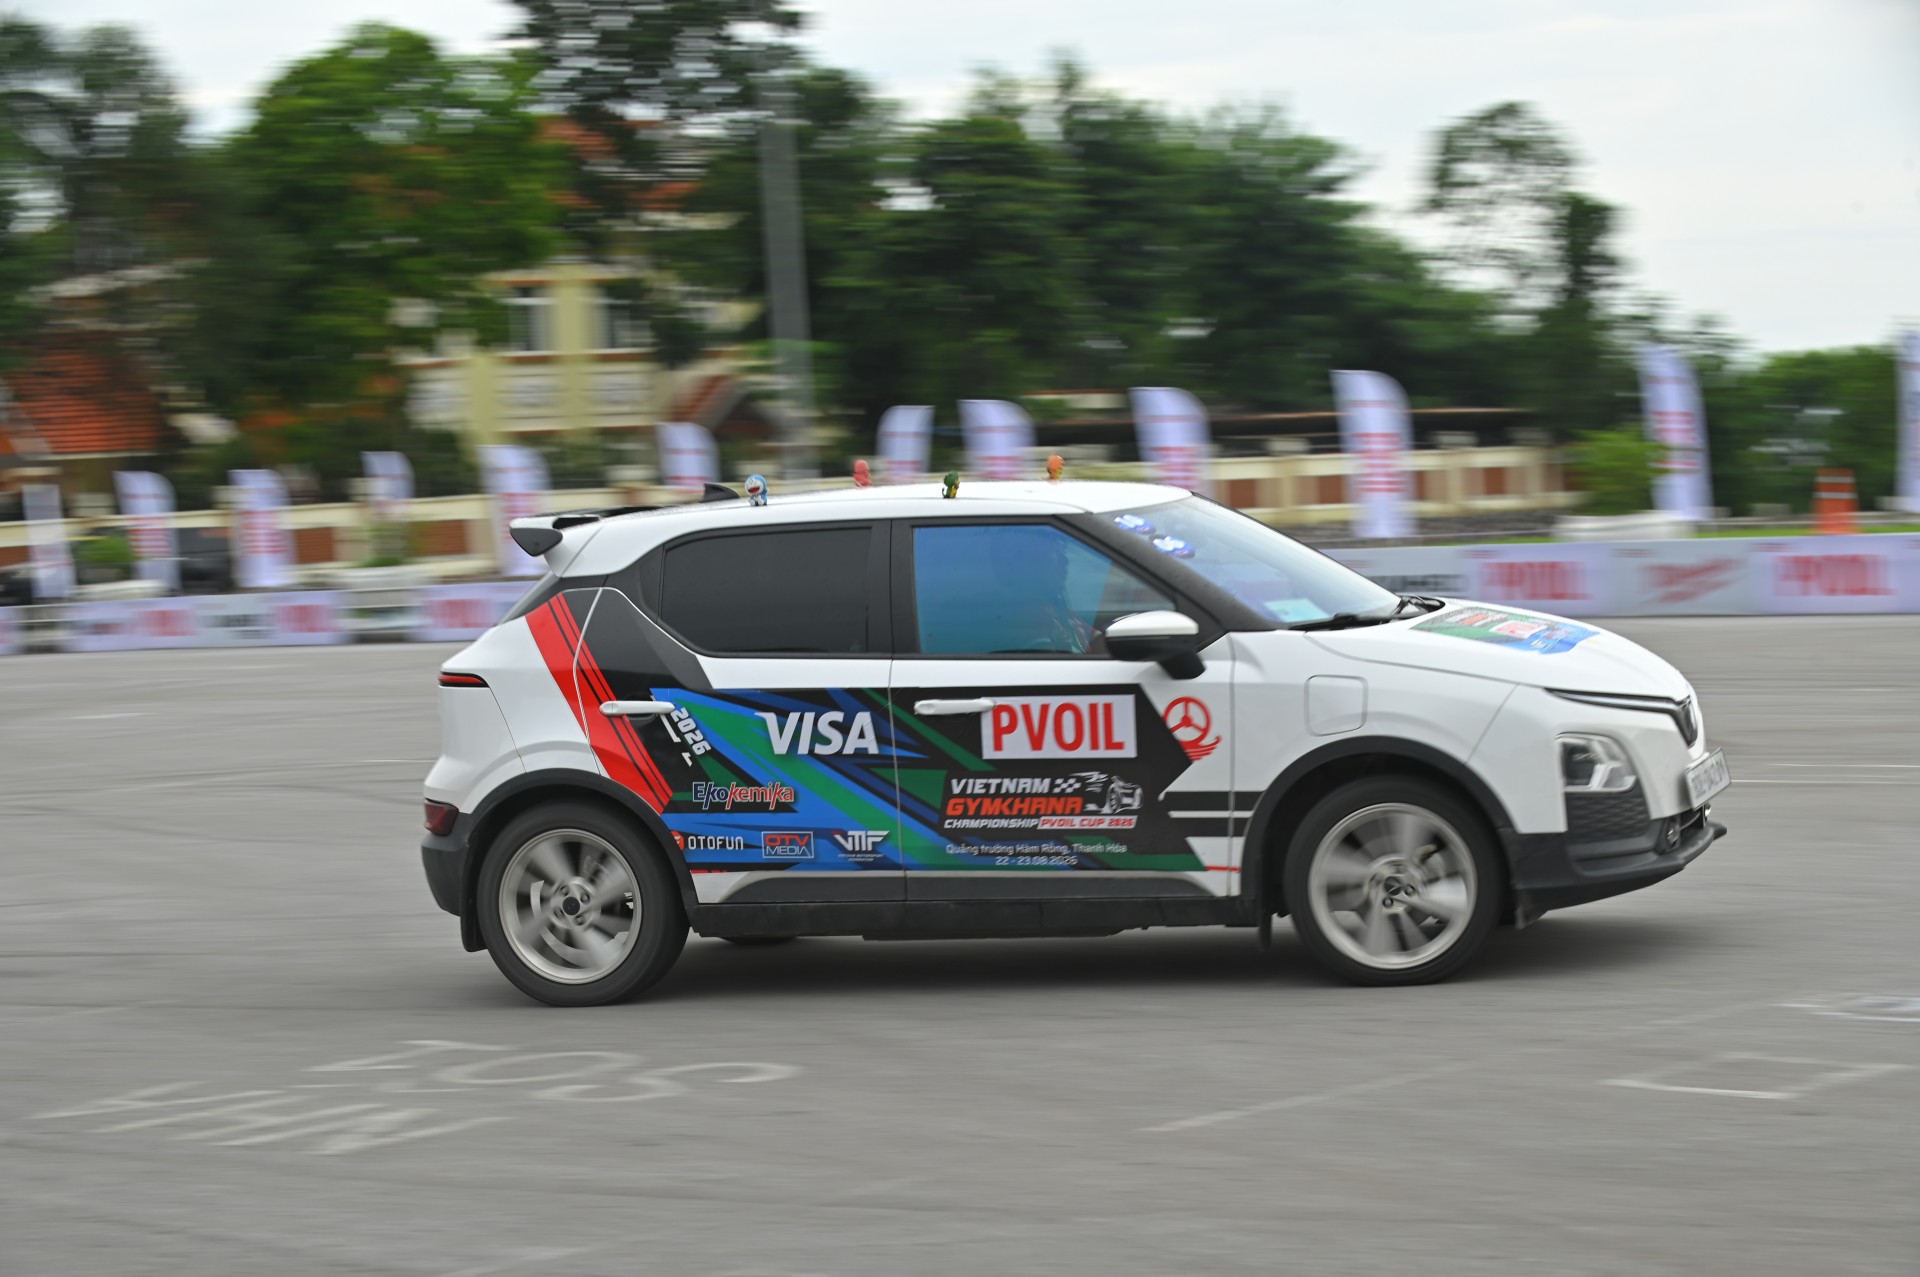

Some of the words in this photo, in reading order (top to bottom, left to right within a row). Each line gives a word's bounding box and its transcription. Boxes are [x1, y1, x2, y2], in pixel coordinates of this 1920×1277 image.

[670, 707, 712, 756] 2026
[754, 711, 880, 755] VISA
[992, 702, 1125, 752] PVOIL
[951, 778, 1052, 794] VIETNAM
[692, 781, 795, 810] Ekokemika
[946, 797, 1084, 816] GYMKHANA
[944, 818, 1039, 829] CHAMPIONSHIP
[1041, 817, 1077, 828] PVOIL
[1079, 817, 1107, 828] CUP
[687, 836, 744, 850] OTOFUN
[765, 834, 811, 846] OTV
[766, 845, 812, 857] MEDIA
[995, 856, 1010, 866] 22
